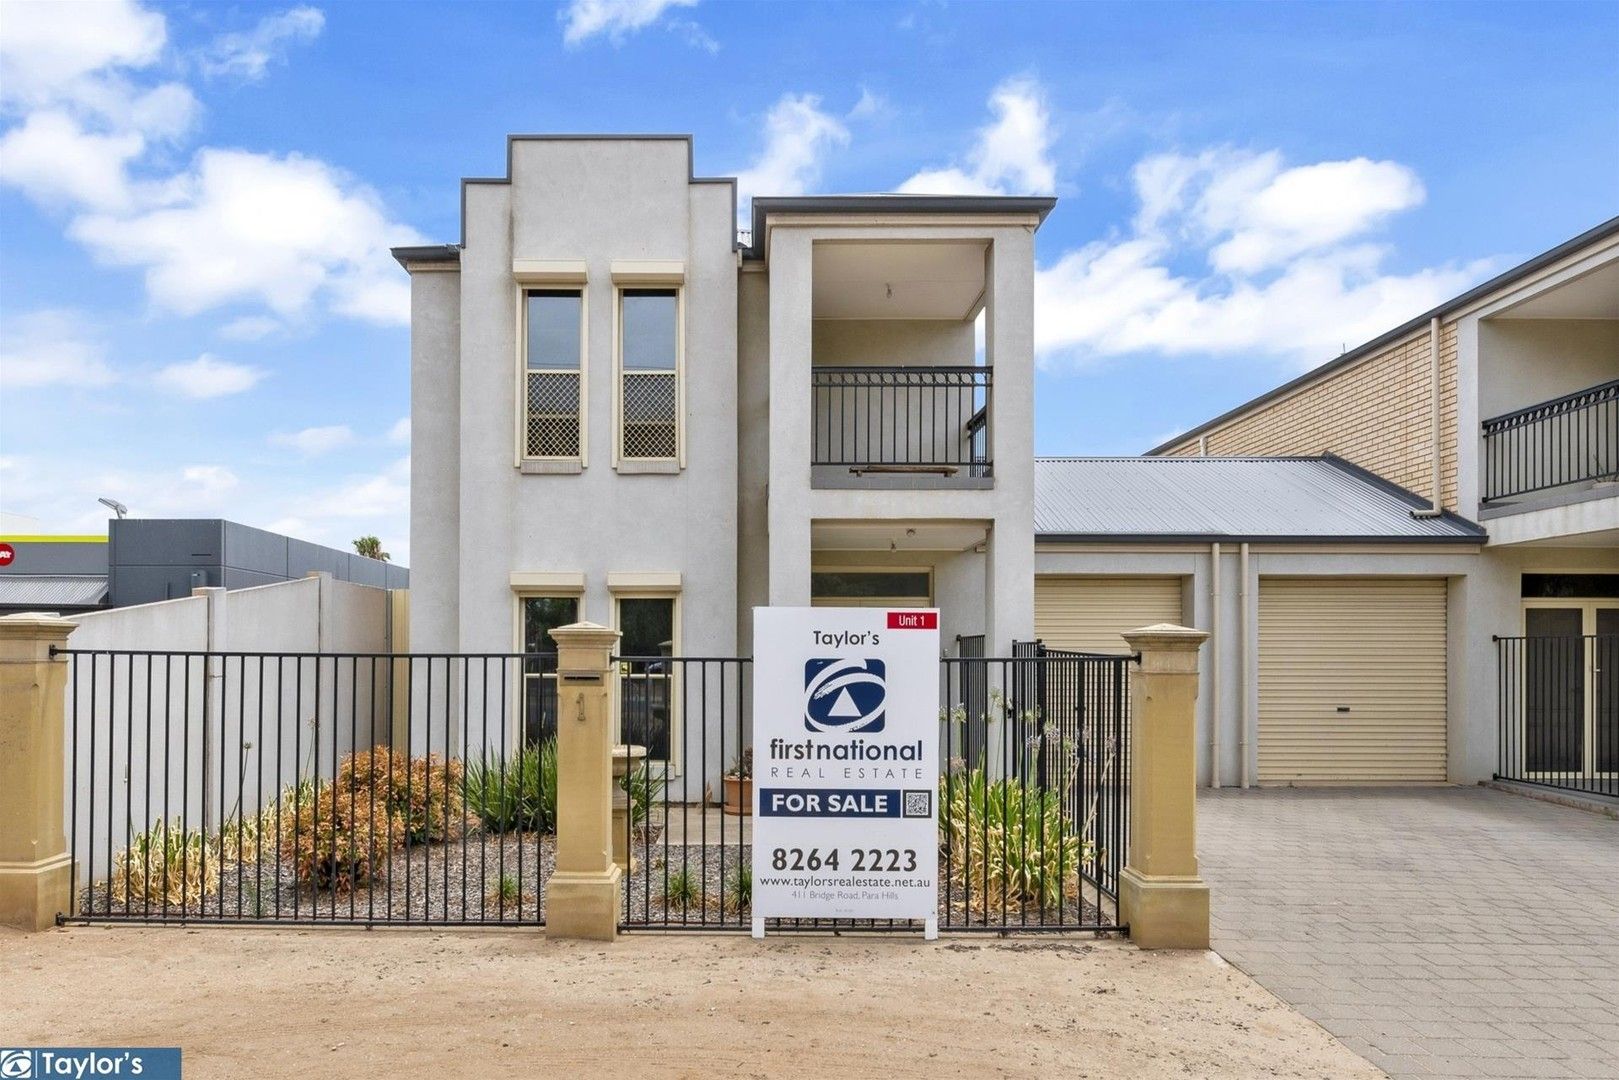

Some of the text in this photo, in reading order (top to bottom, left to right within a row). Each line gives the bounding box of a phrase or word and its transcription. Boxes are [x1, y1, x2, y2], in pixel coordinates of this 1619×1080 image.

[898, 612, 926, 626] Unit 1
[813, 630, 880, 648] Taylor's
[771, 767, 922, 780] REAL ESTATE
[772, 794, 888, 813] FOR SALE
[772, 848, 917, 872] 8264 2223
[759, 876, 931, 889] www.taylorsrealestate.net.au
[791, 890, 806, 900] 411
[809, 890, 835, 901] Bridge
[861, 891, 879, 900] Para
[881, 891, 899, 900] Hills
